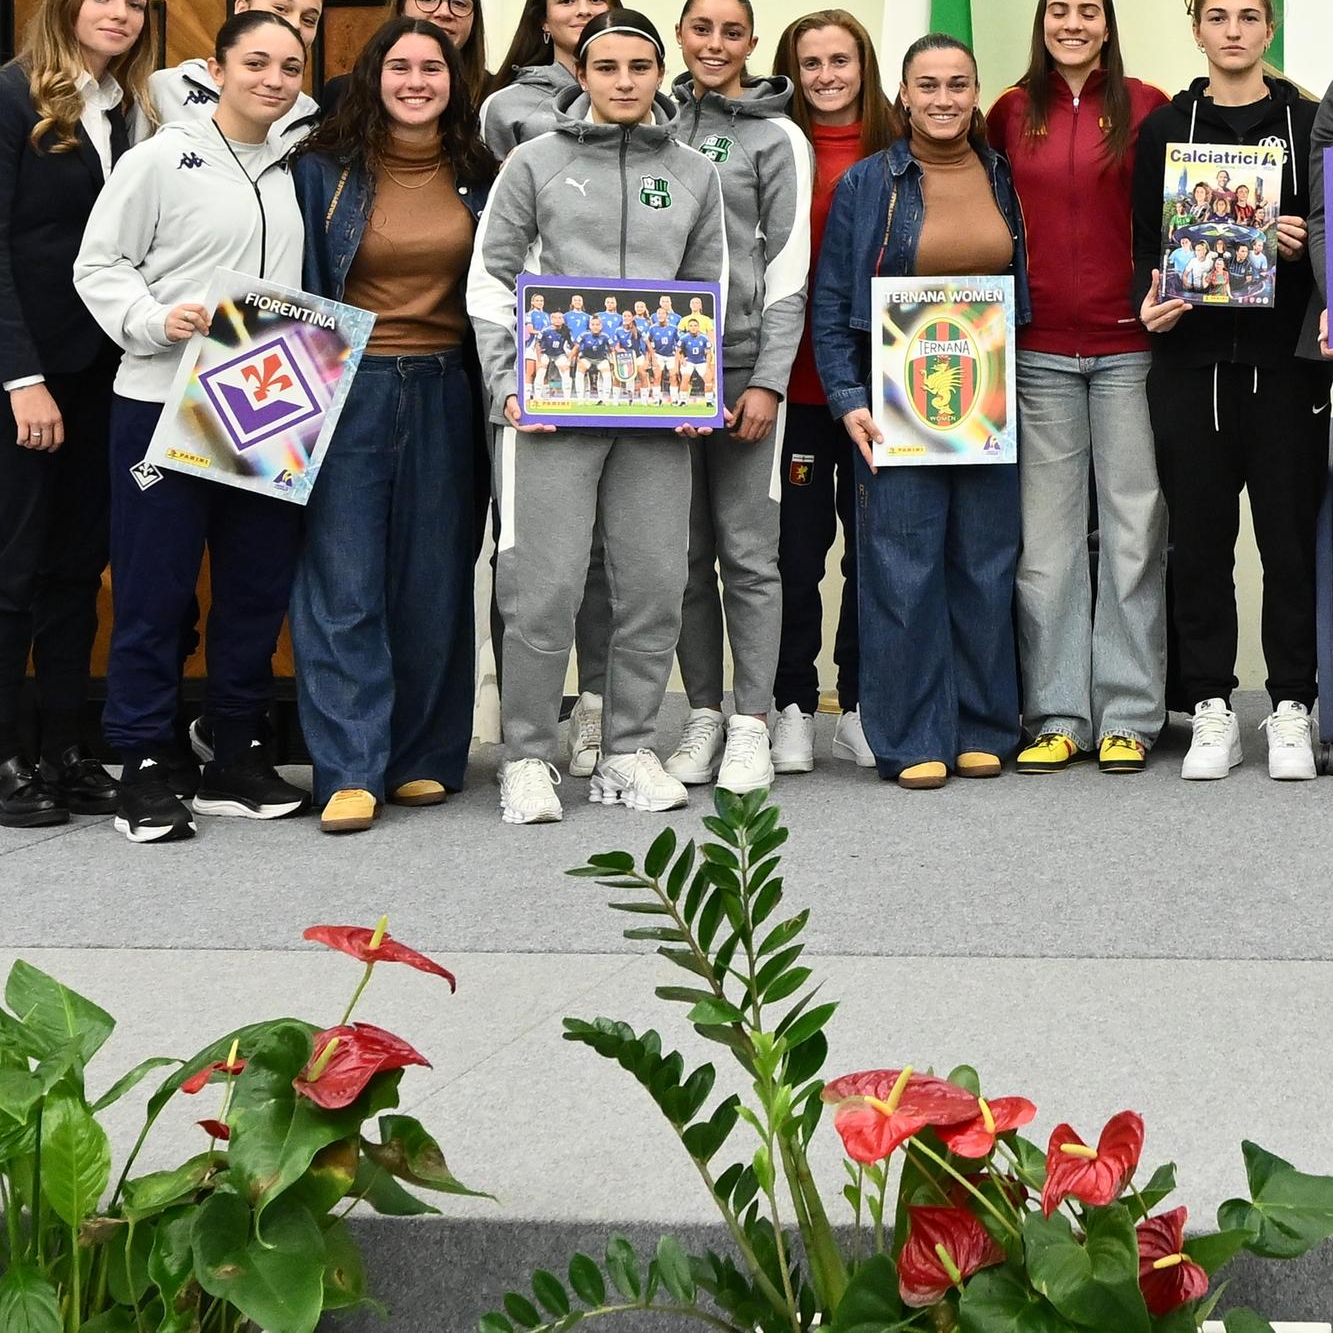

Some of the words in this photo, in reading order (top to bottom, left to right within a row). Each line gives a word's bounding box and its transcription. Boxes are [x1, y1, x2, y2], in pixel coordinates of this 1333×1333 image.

[1170, 149, 1258, 165] Calciatrici
[885, 291, 946, 303] TERNANA
[948, 290, 1003, 303] WOMEN
[244, 292, 337, 330] FIORENTINA
[919, 340, 970, 355] TERNANA
[178, 451, 210, 465] PANINI
